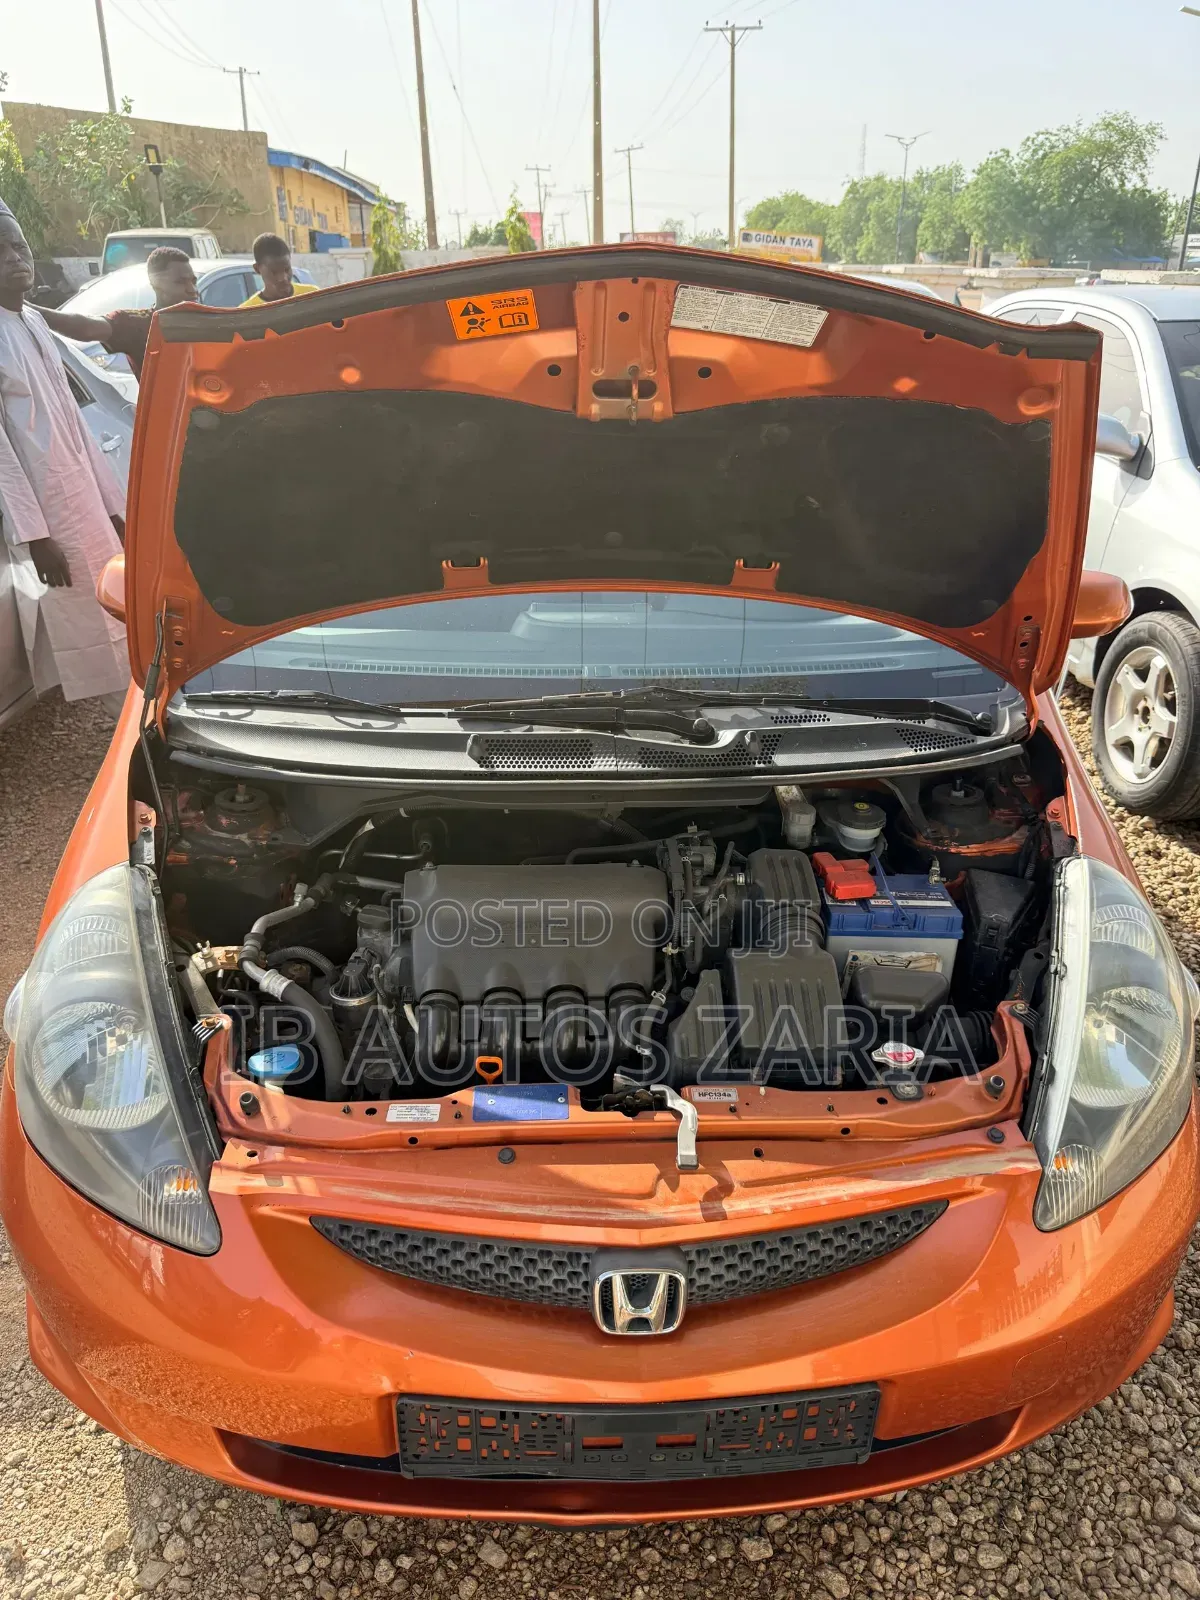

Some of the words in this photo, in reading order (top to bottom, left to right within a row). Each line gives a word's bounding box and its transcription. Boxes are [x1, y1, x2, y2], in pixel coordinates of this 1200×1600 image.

[754, 233, 785, 245] GIDAN
[790, 237, 813, 248] TAYA
[491, 296, 528, 305] SRS
[492, 302, 529, 310] AIRBAG
